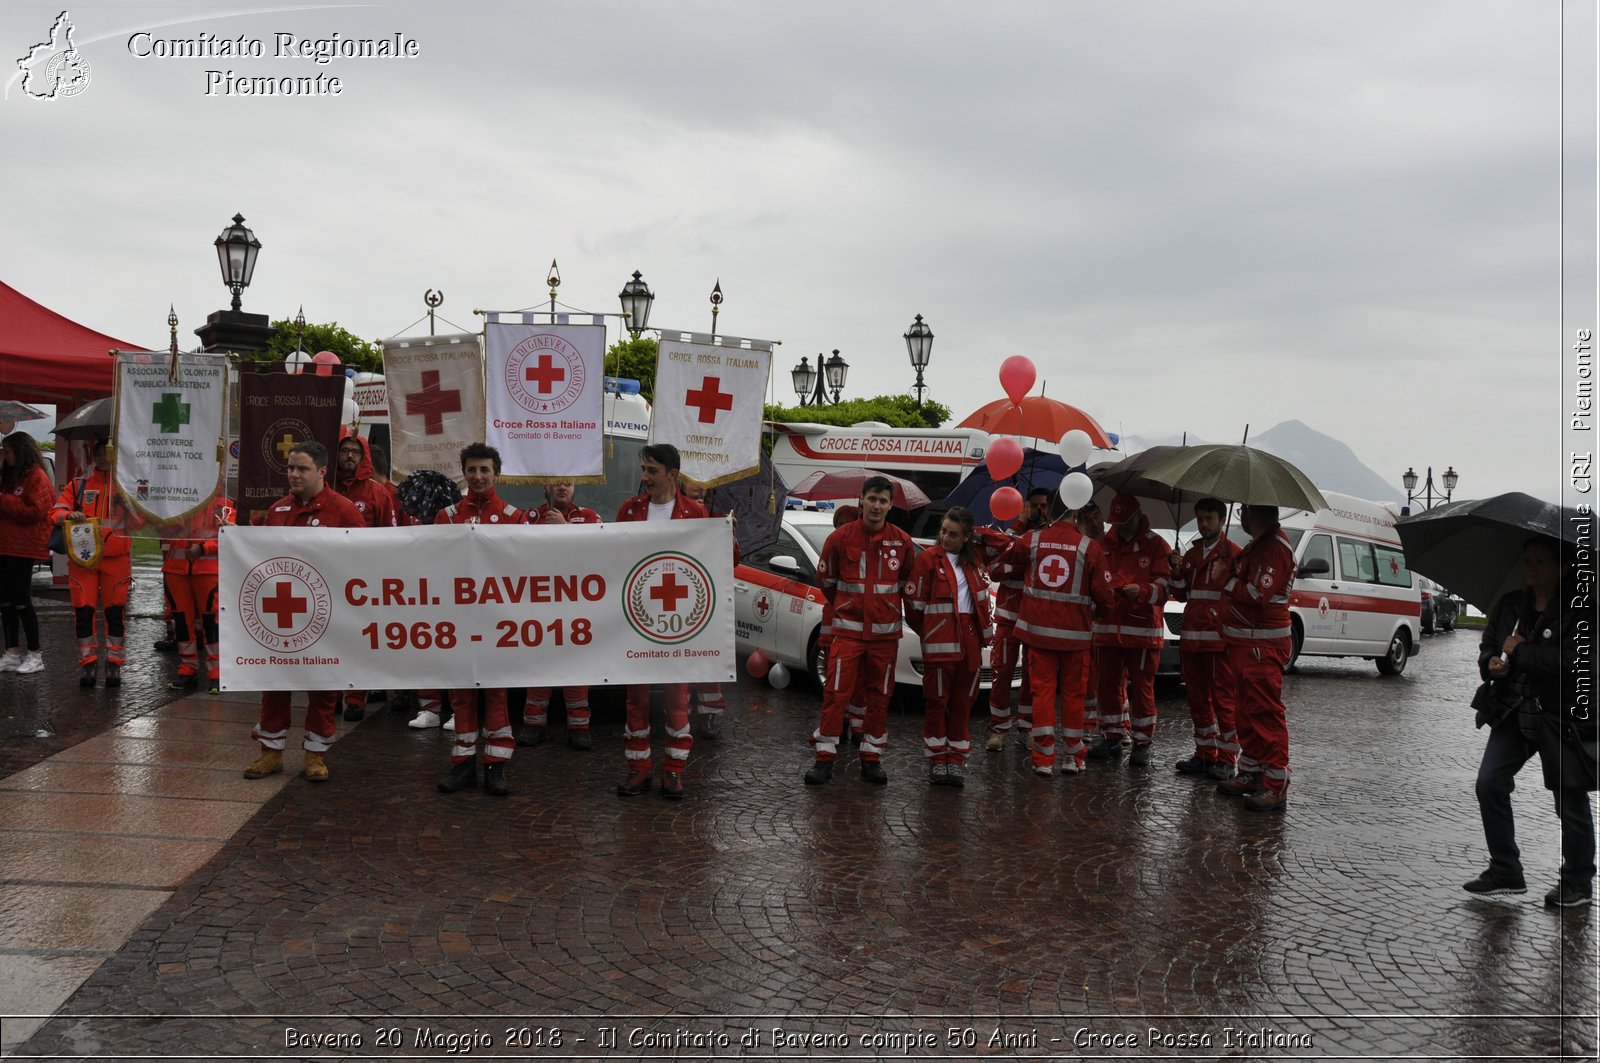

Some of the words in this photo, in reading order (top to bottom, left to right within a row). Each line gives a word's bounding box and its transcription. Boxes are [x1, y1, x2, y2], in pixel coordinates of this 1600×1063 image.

[527, 336, 567, 353] GINEVRA
[415, 353, 439, 362] ROSSA
[441, 351, 475, 361] ITALIANA
[516, 346, 528, 357] DI
[566, 351, 578, 363] 22
[668, 351, 692, 363] CROCE
[697, 354, 721, 365] ROSSA
[726, 357, 759, 369] ITALIANA
[127, 367, 169, 376] ASSOCIAZIO
[133, 380, 166, 388] PUBBLICA
[169, 381, 210, 389] ASSISTENZA
[506, 356, 539, 411] CONVENZIONE
[567, 363, 584, 400] AGOSTO
[245, 395, 270, 407] CROCE
[274, 394, 301, 406] ROSSA
[304, 395, 337, 408] ITALIANA
[551, 399, 570, 411] 1864
[493, 419, 523, 429] Croce
[525, 419, 557, 429] Rossa
[560, 419, 596, 430] Italiana
[607, 420, 648, 431] BAVENO
[146, 438, 169, 446] CROCE
[170, 439, 194, 447] VERDE
[507, 432, 542, 440] Comitato
[543, 432, 551, 440] di
[552, 432, 582, 441] Baveno
[686, 434, 724, 446] COMITATO
[819, 437, 857, 450] CROCE
[861, 438, 901, 452] ROSSA
[904, 439, 963, 454] ITALIANA
[135, 450, 181, 459] GRAVELLONA
[184, 452, 203, 460] TOCE
[150, 486, 198, 495] PROVINCIA
[1332, 508, 1353, 520] CROCE
[1353, 512, 1372, 523] ROSSA
[253, 568, 265, 581] DI
[265, 561, 311, 581] GINEVRA
[309, 577, 324, 592] 22
[344, 577, 440, 607] C.R.I.
[454, 573, 607, 605] BAVENO
[242, 580, 280, 648] CONVENZIONE
[311, 592, 328, 636] AGOSTO
[656, 613, 683, 634] 50
[737, 620, 763, 633] BAVENO
[292, 632, 314, 648] 1864
[362, 621, 457, 650] 1968
[471, 634, 483, 642] -
[496, 617, 593, 648] 2018
[235, 656, 267, 665] Croce
[269, 656, 300, 665] Rossa
[302, 655, 340, 665] Italiana
[626, 649, 670, 659] Comitato
[672, 649, 681, 658] di
[684, 648, 720, 658] Baveno
